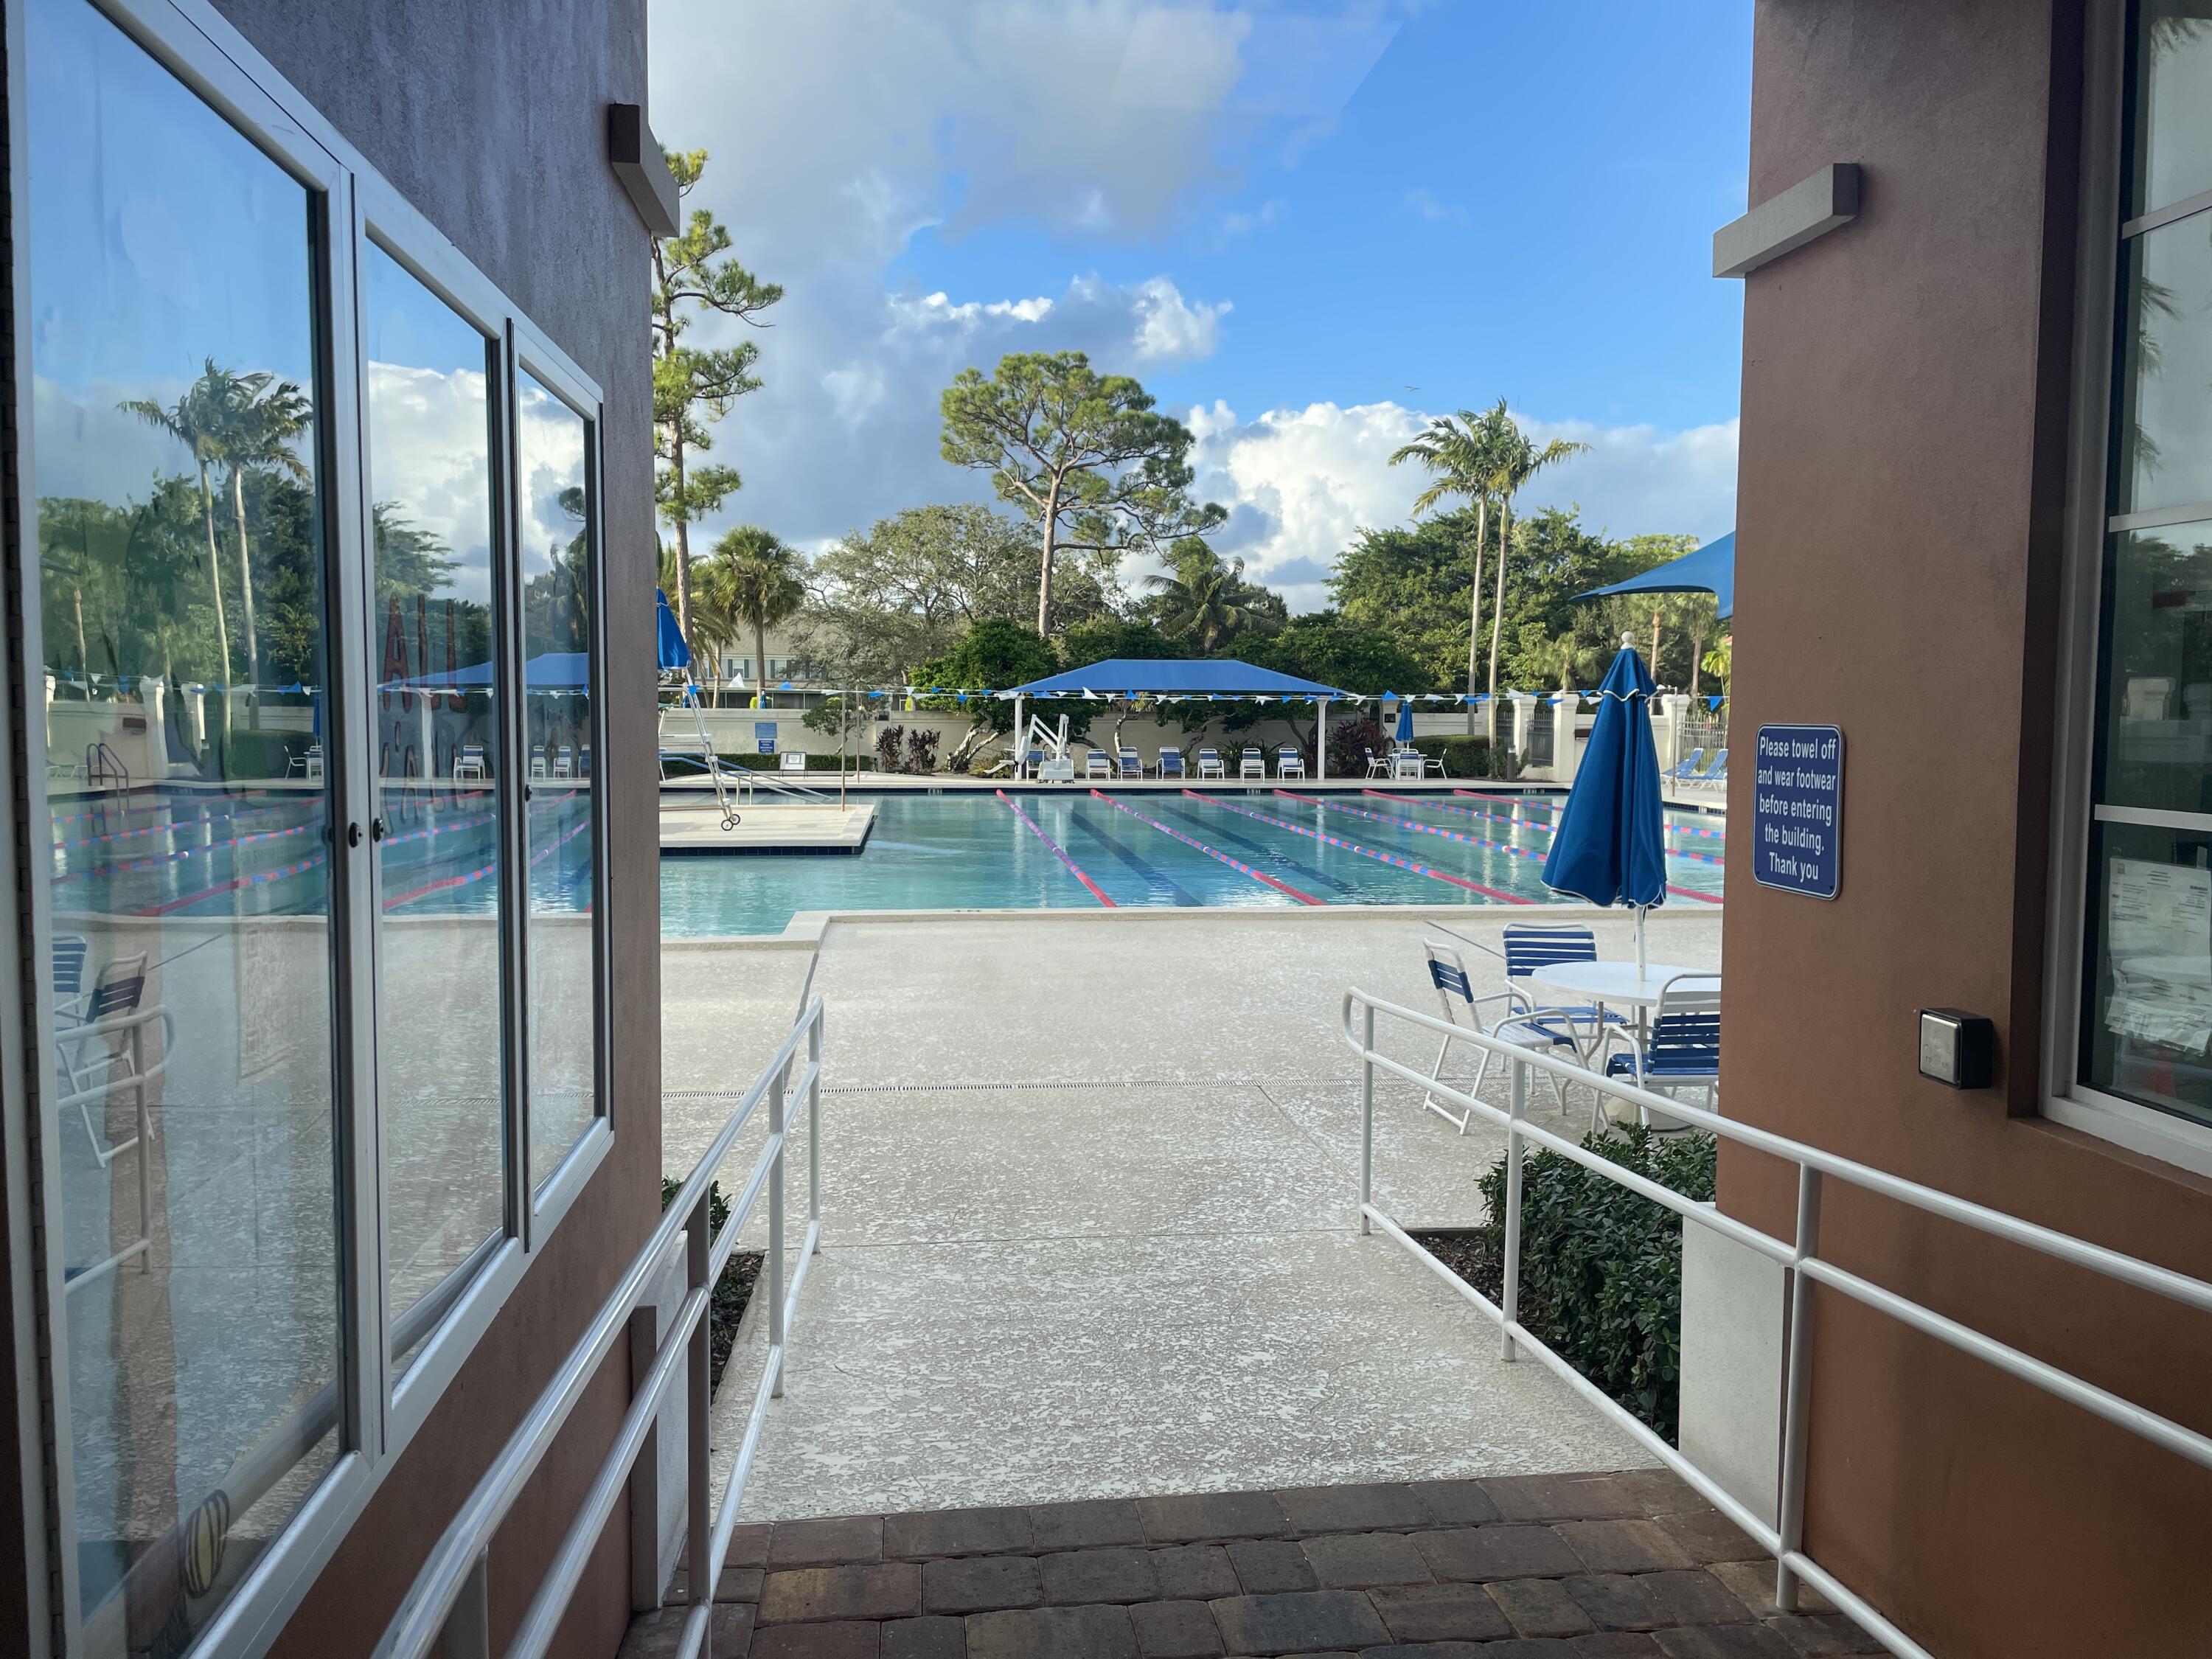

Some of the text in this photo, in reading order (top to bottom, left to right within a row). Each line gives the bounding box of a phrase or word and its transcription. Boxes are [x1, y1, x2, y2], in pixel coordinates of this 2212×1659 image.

[1759, 736, 1837, 759] Please towel off
[1758, 765, 1836, 791] and wear footwear
[1759, 793, 1832, 827] before entering
[1764, 822, 1825, 856] the building.
[1769, 852, 1818, 883] Thank you
